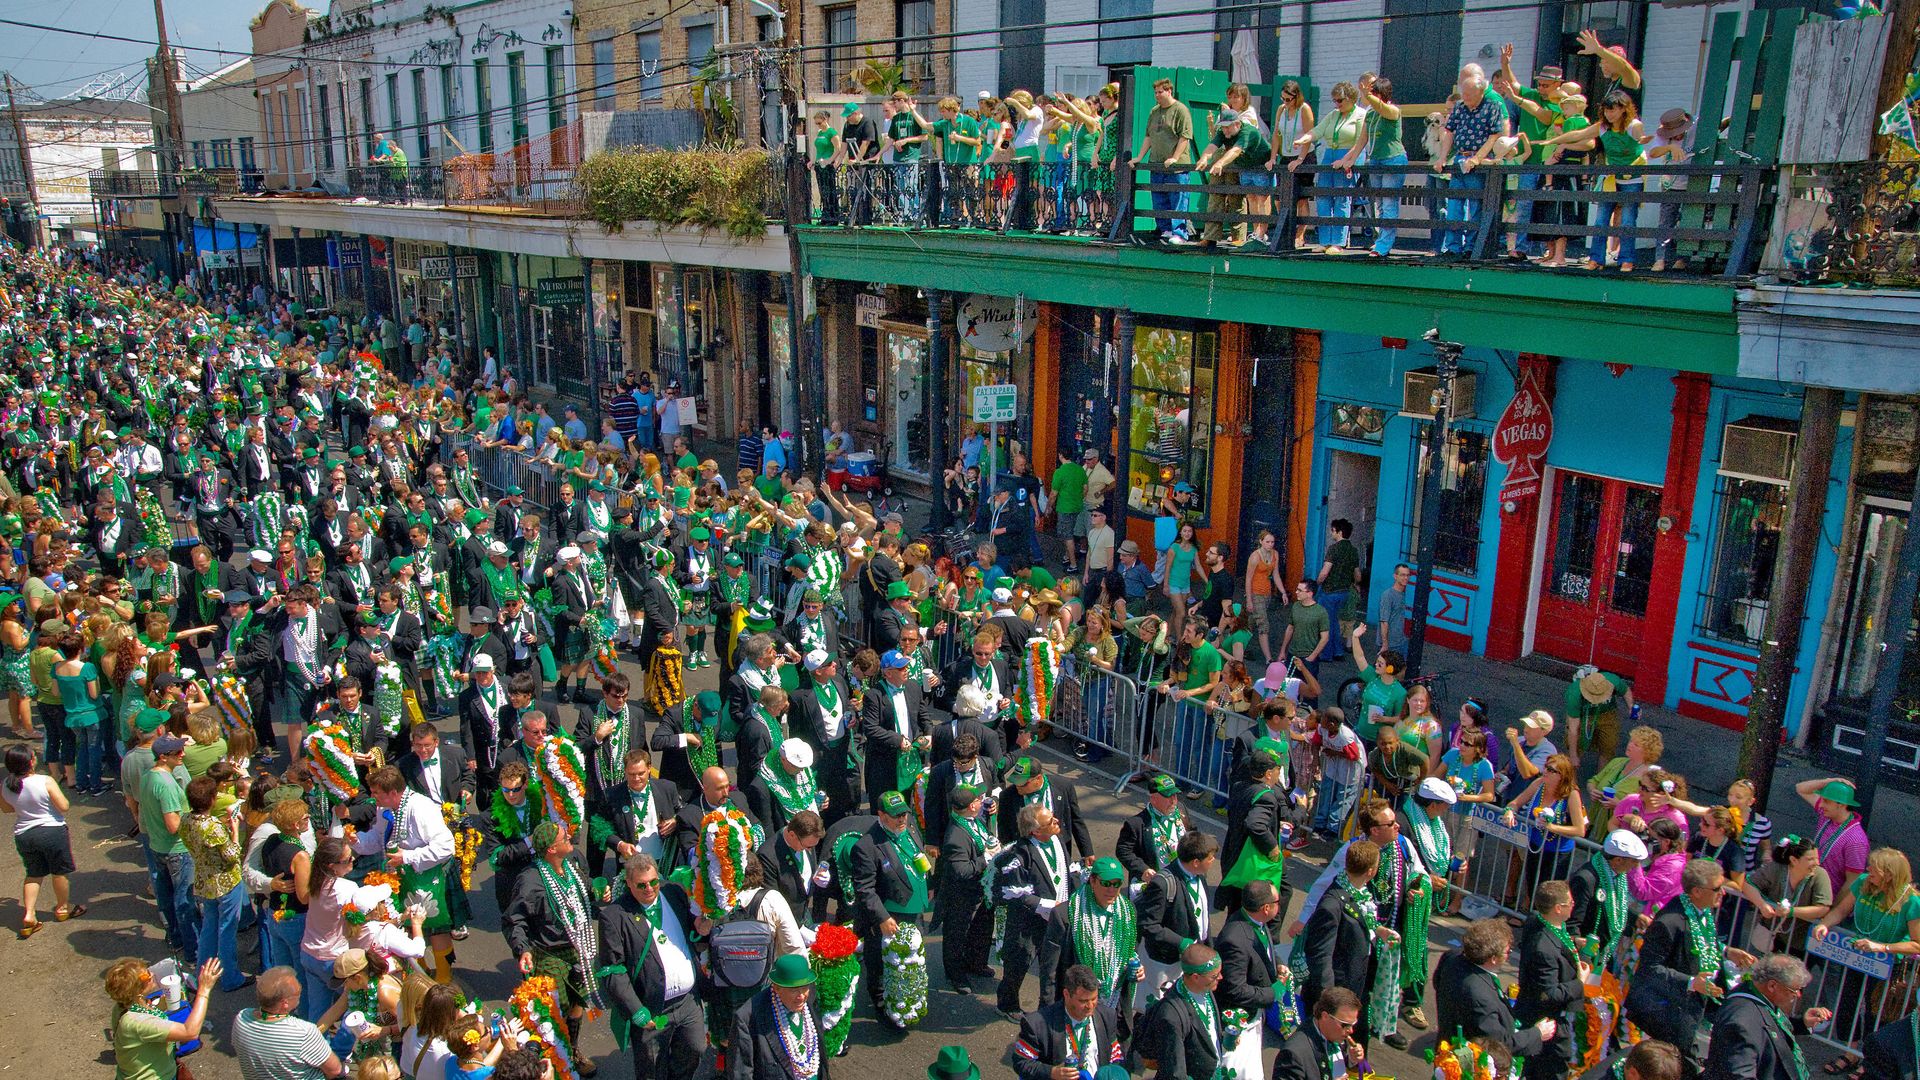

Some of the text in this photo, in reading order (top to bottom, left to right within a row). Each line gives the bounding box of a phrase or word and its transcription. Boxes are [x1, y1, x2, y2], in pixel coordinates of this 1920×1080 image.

[425, 257, 475, 268] ANTIUES
[425, 267, 476, 278] MAGINE
[540, 281, 566, 291] METRO
[857, 293, 886, 311] MAGAZI
[976, 386, 1016, 396] PAY TO PARK
[983, 396, 989, 406] 2
[1501, 423, 1546, 447] VEGAS
[1019, 488, 1026, 501] P
[1502, 485, 1537, 500] A MEN'S STORE
[1814, 946, 1880, 975] DO NOT CROSS
[1822, 942, 1876, 968] POLICE LINE
